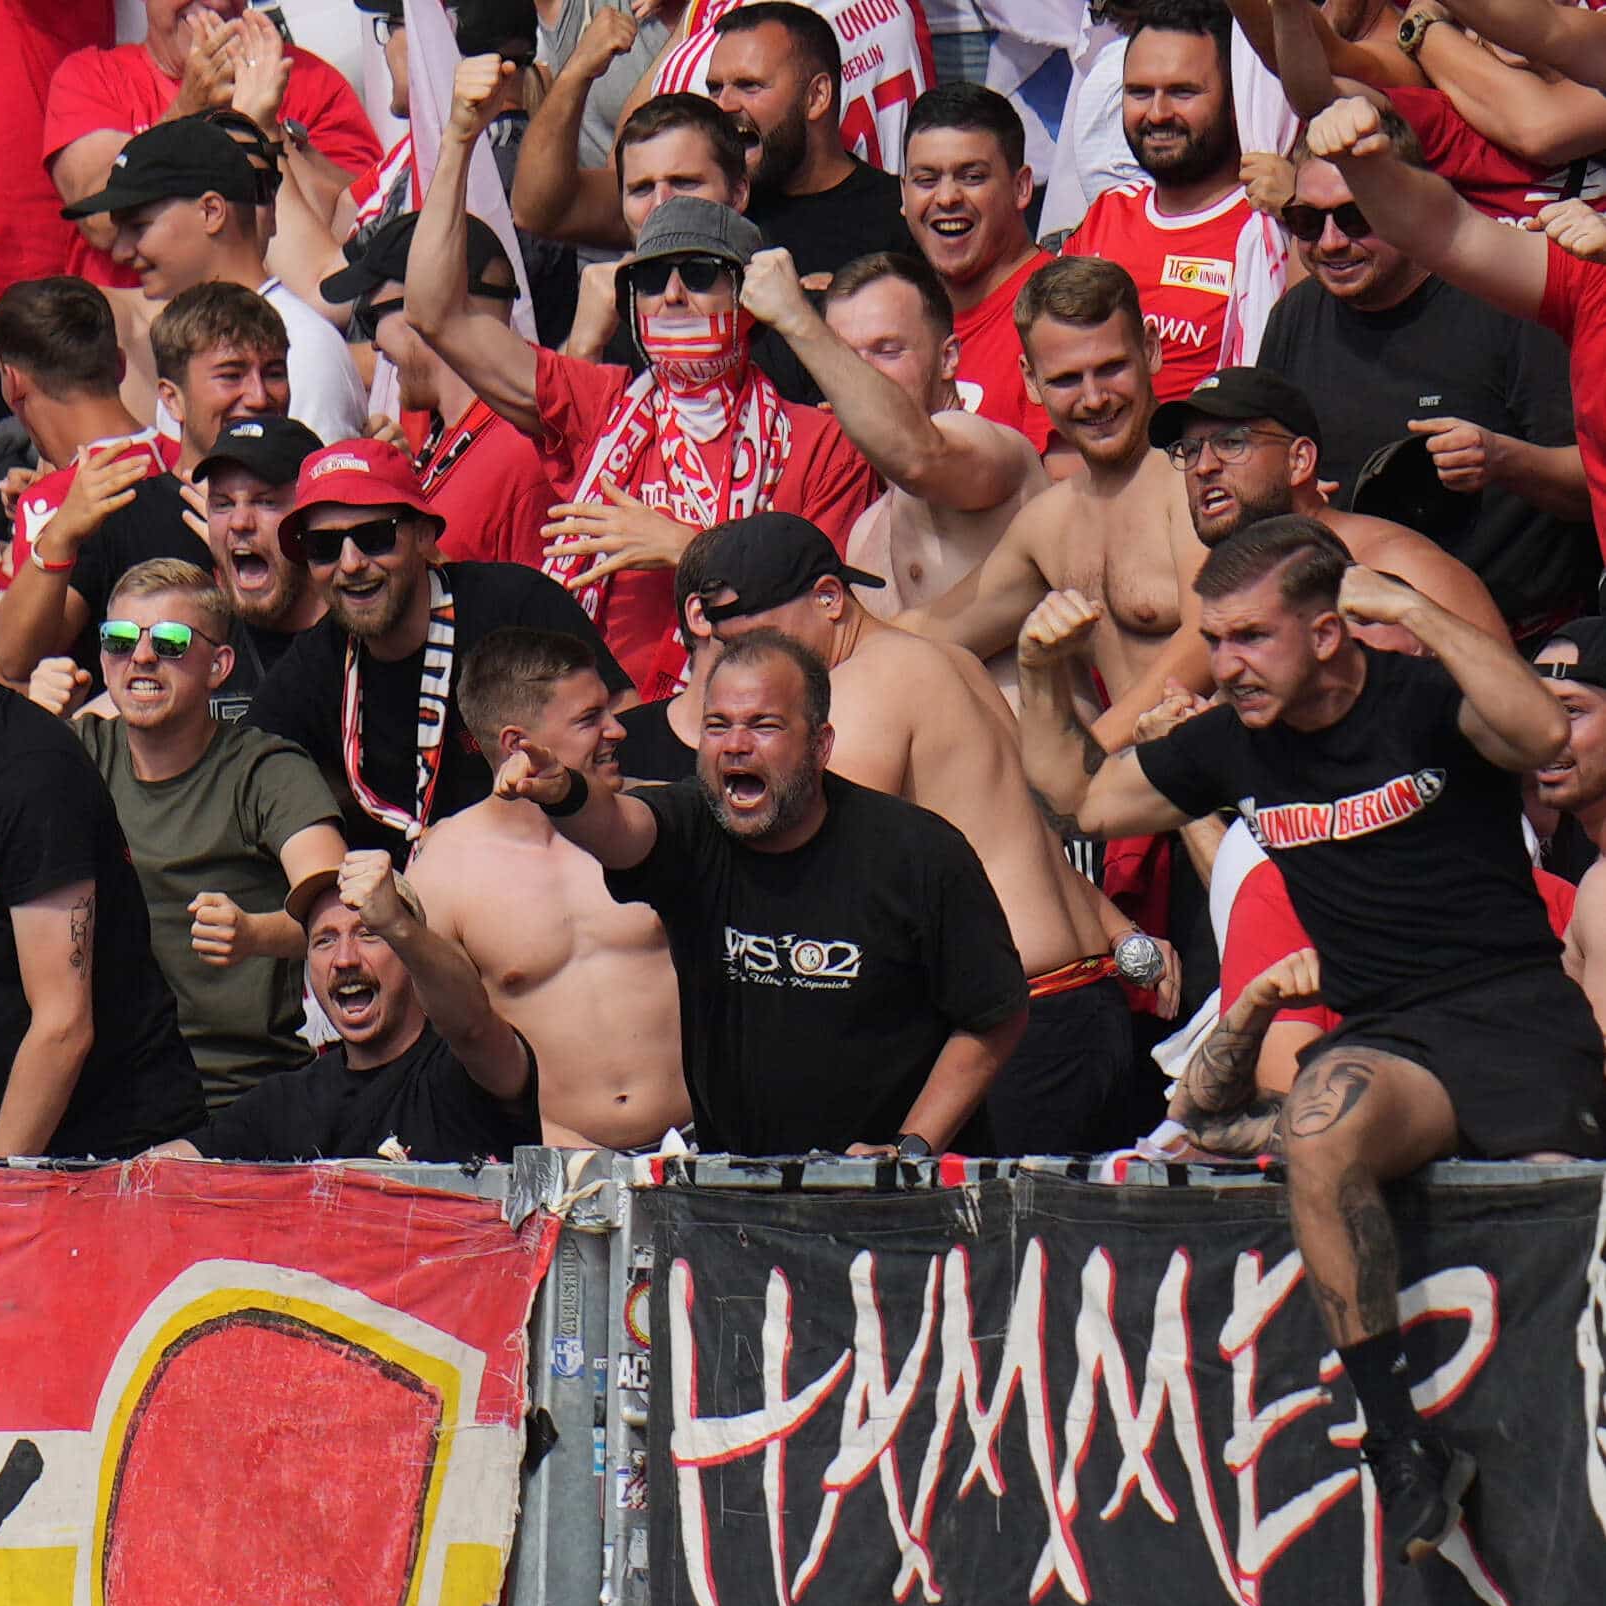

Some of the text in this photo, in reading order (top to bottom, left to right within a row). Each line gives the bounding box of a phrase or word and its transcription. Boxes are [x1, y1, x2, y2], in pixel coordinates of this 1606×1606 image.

[840, 44, 884, 82] BERLIN
[1258, 804, 1332, 846] UNION
[1337, 777, 1422, 836] BERLIN
